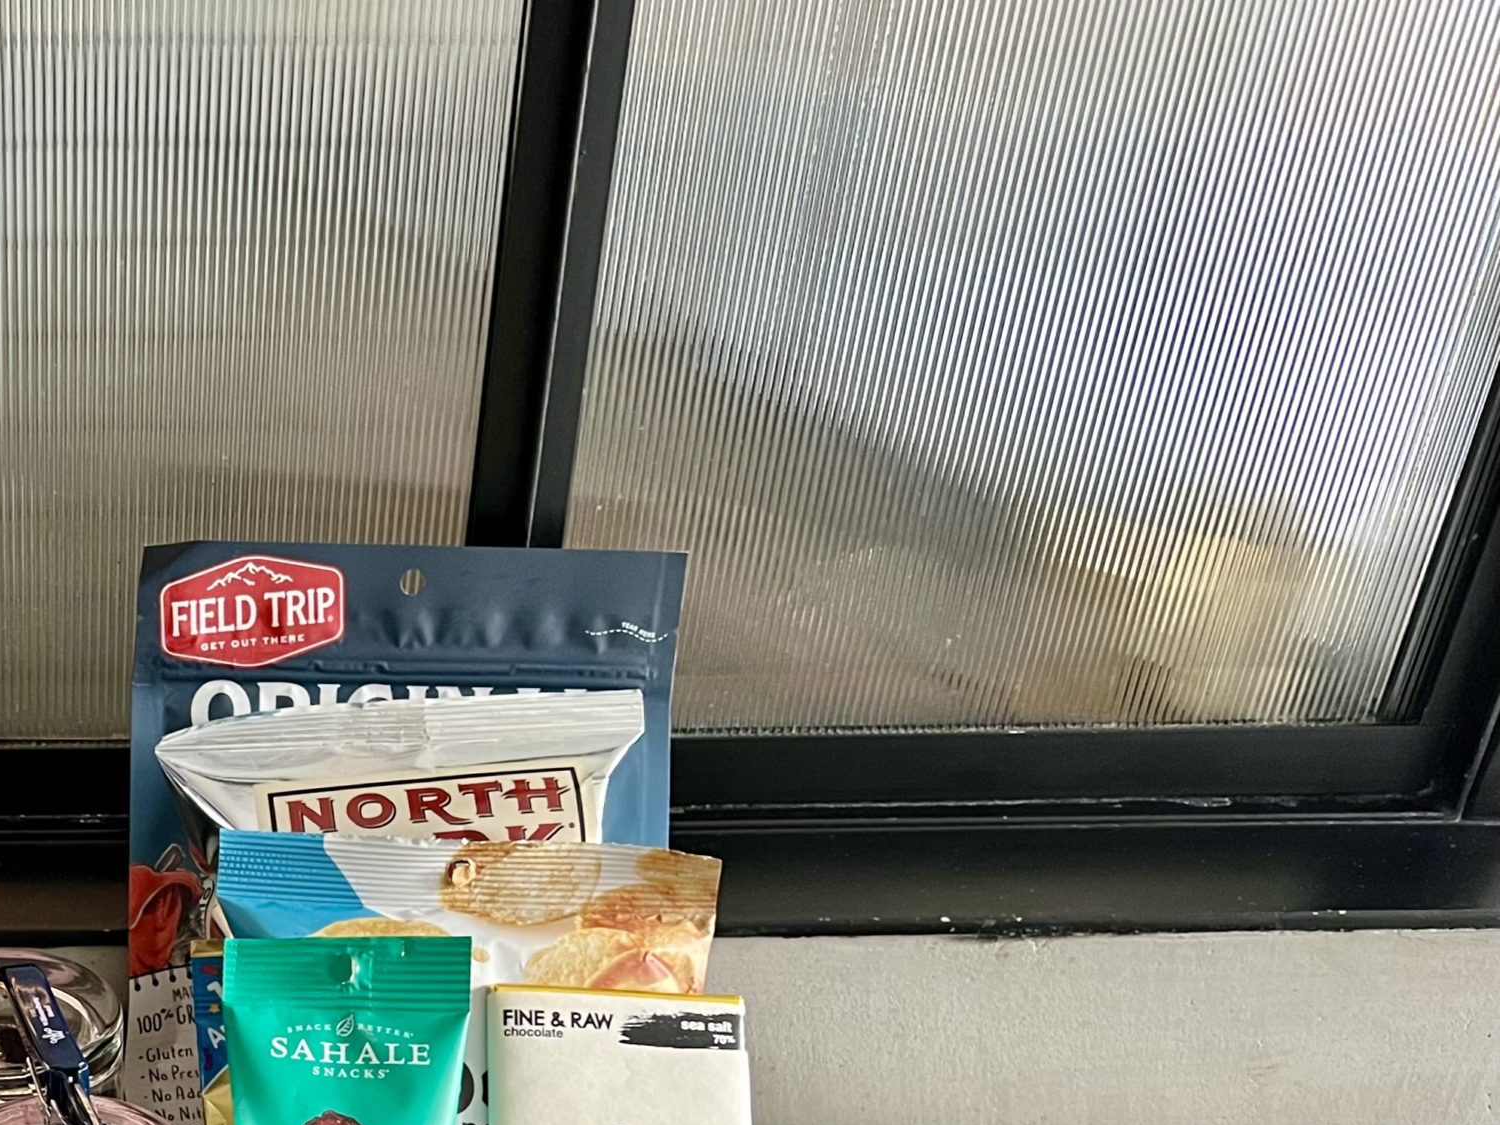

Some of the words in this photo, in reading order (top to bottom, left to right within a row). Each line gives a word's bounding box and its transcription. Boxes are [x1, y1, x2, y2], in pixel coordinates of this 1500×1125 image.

[170, 594, 257, 637] FIELD
[263, 587, 336, 628] TRIP
[201, 641, 225, 652] GET
[230, 637, 257, 649] OUT
[262, 633, 305, 646] THERE
[287, 776, 571, 833] NORTH
[137, 1008, 174, 1035] 100%
[503, 1009, 545, 1026] FINE
[551, 1011, 566, 1028] &
[571, 1011, 613, 1030] RAW
[681, 1020, 705, 1031] sea
[707, 1020, 733, 1033] salt
[287, 1022, 332, 1034] SNACK
[357, 1022, 414, 1039] BETTER
[503, 1027, 564, 1039] chocolate
[270, 1036, 431, 1066] SAHALE
[149, 1067, 168, 1082] No
[312, 1066, 390, 1079] SNACKS
[152, 1088, 172, 1102] No
